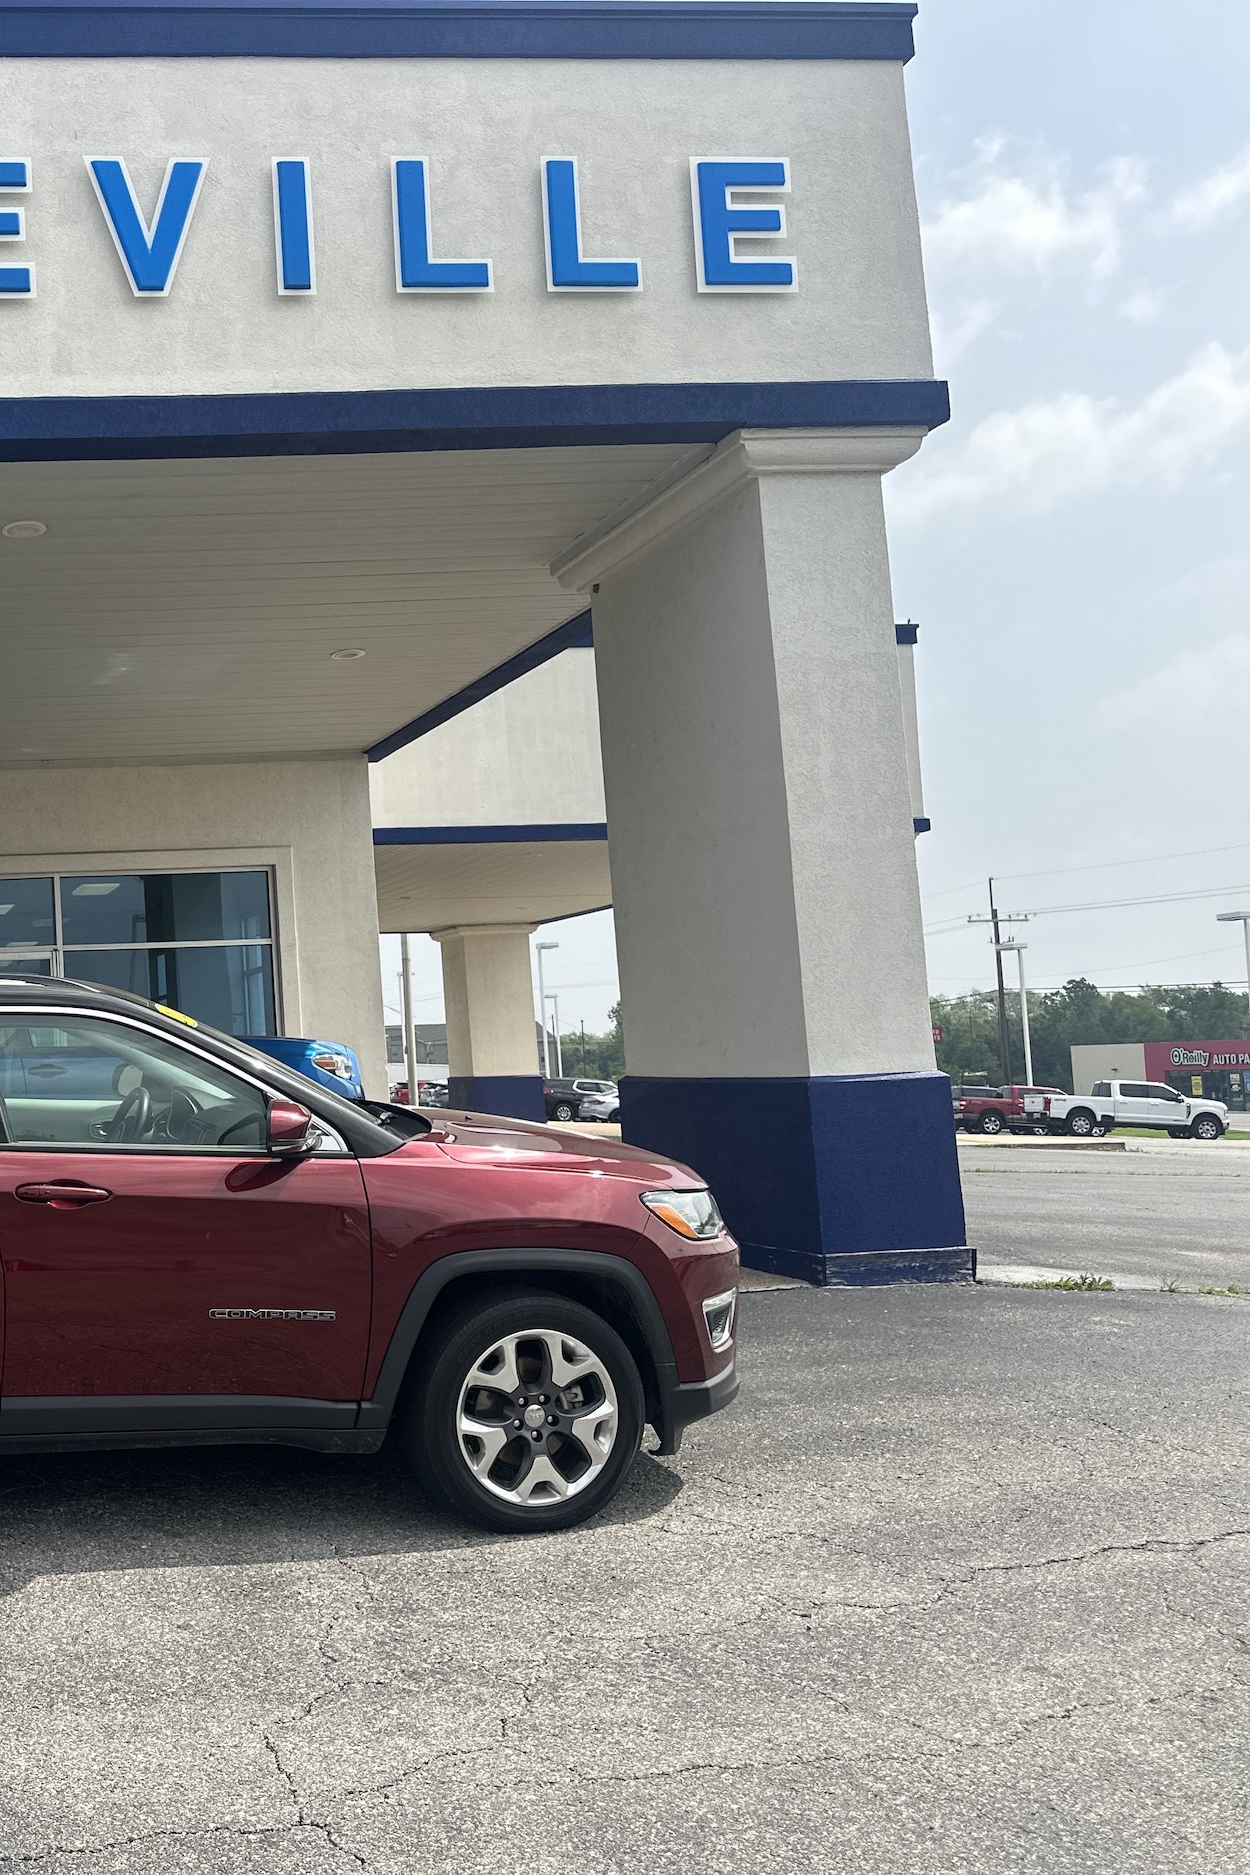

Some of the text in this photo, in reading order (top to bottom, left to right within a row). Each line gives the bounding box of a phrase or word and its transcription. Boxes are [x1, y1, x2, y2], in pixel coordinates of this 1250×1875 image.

[1170, 1048, 1210, 1067] O'Reilly
[1213, 1054, 1237, 1065] AUTO
[209, 1309, 336, 1320] COMPASS
